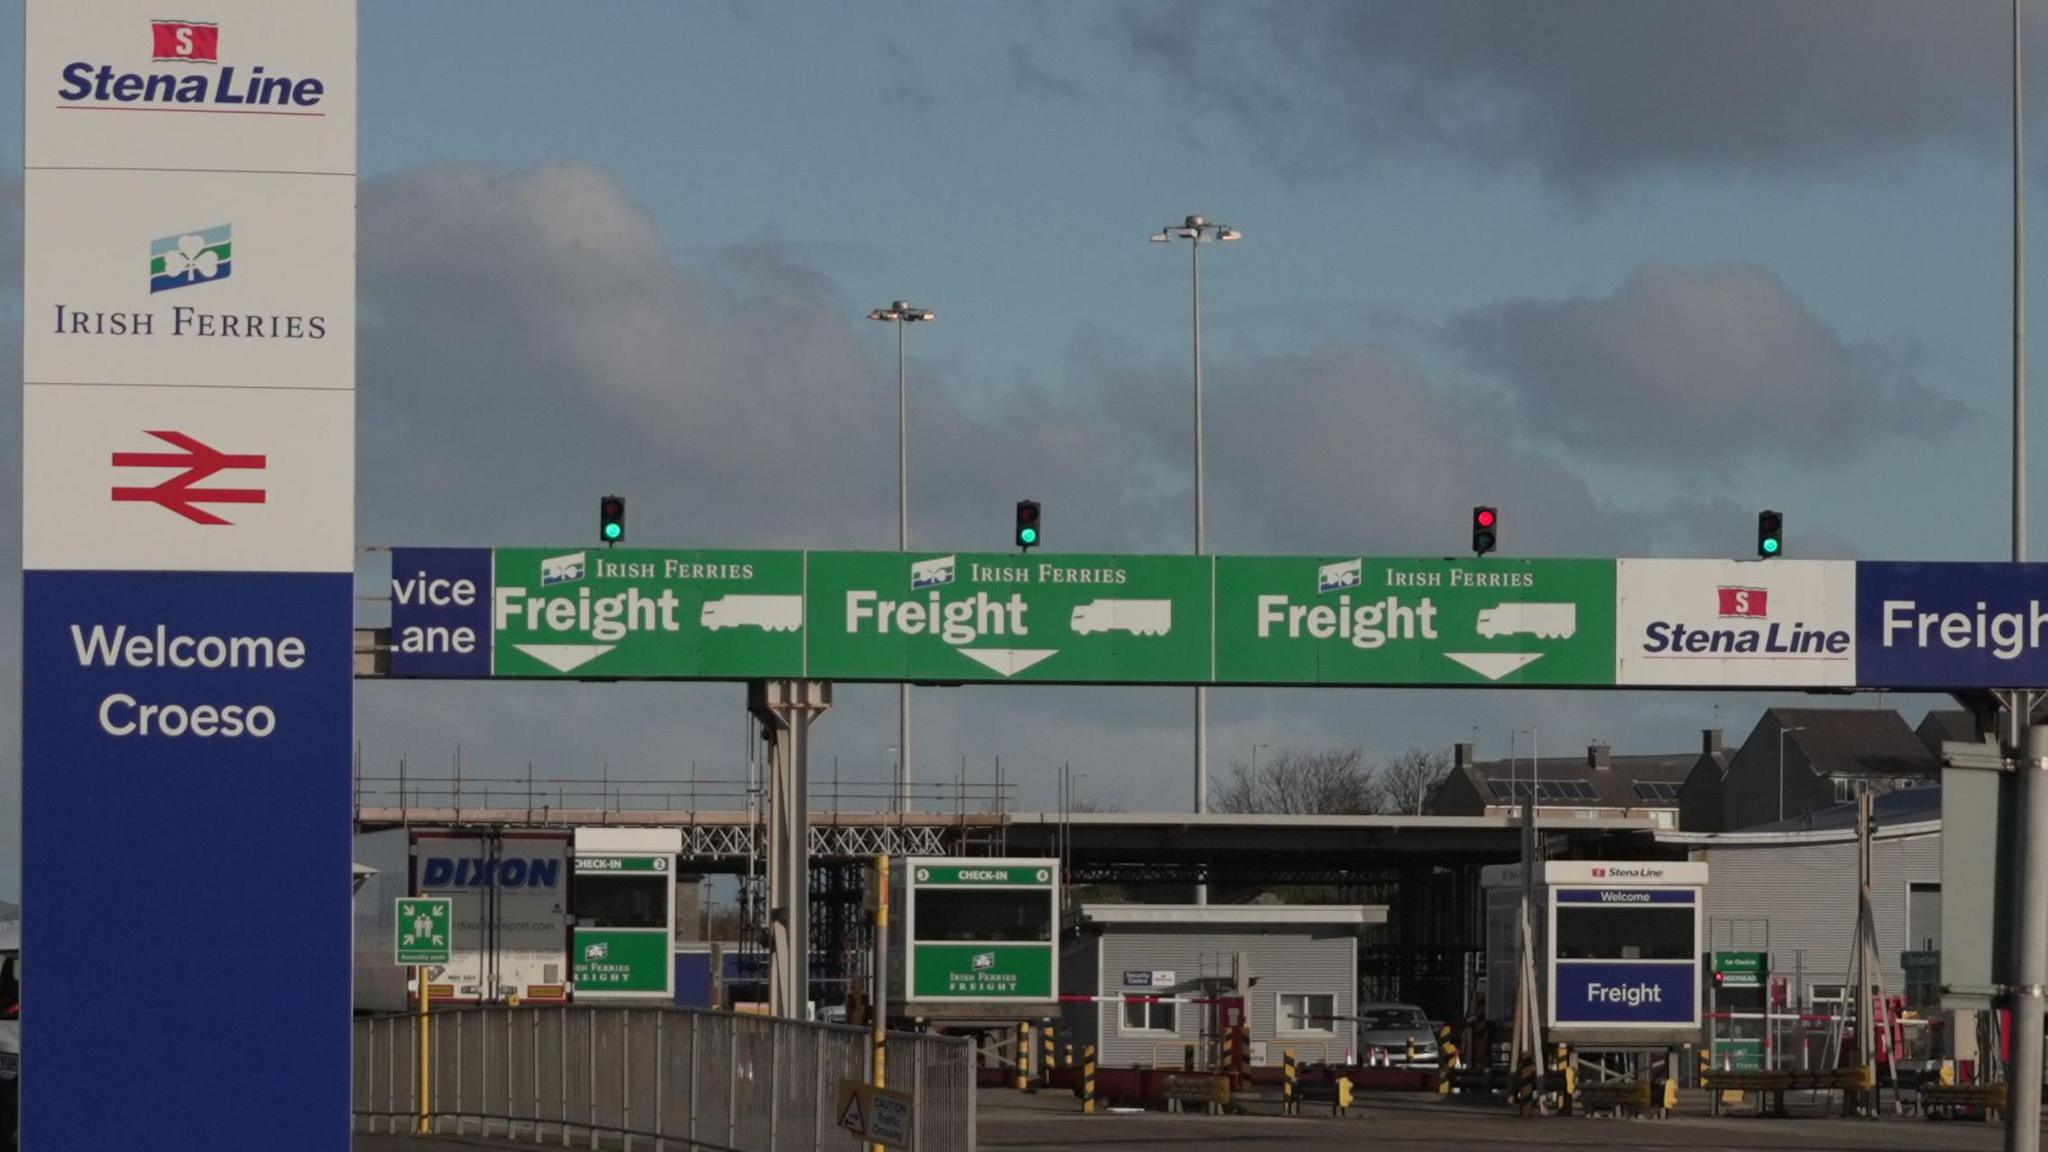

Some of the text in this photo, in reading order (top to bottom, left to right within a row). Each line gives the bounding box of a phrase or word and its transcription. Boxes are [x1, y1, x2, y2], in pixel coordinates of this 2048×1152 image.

[176, 27, 193, 55] S
[58, 61, 324, 106] Stena Line
[55, 304, 326, 339] IRISH FERRIES
[596, 559, 754, 579] IRISH FERRIES
[972, 563, 1127, 584] IRISH FERRIES
[1386, 568, 1534, 587] IRISH FERRIES
[391, 571, 476, 606] vice
[1735, 591, 1750, 614] S
[495, 587, 680, 641] Freight
[846, 590, 1028, 645] Freight
[1257, 595, 1438, 649] Freight
[70, 623, 306, 669] Welcome
[390, 626, 476, 653] ane
[1642, 621, 1850, 655] Stena Line
[99, 693, 276, 737] Croeso
[423, 857, 559, 888] DIXON
[958, 870, 1008, 881] CHECK-IN
[1609, 867, 1639, 877] Stena
[1640, 868, 1663, 877] Line
[1601, 891, 1650, 901] Welcome
[950, 982, 1017, 991] FREIGHT
[1588, 983, 1661, 1006] Freight
